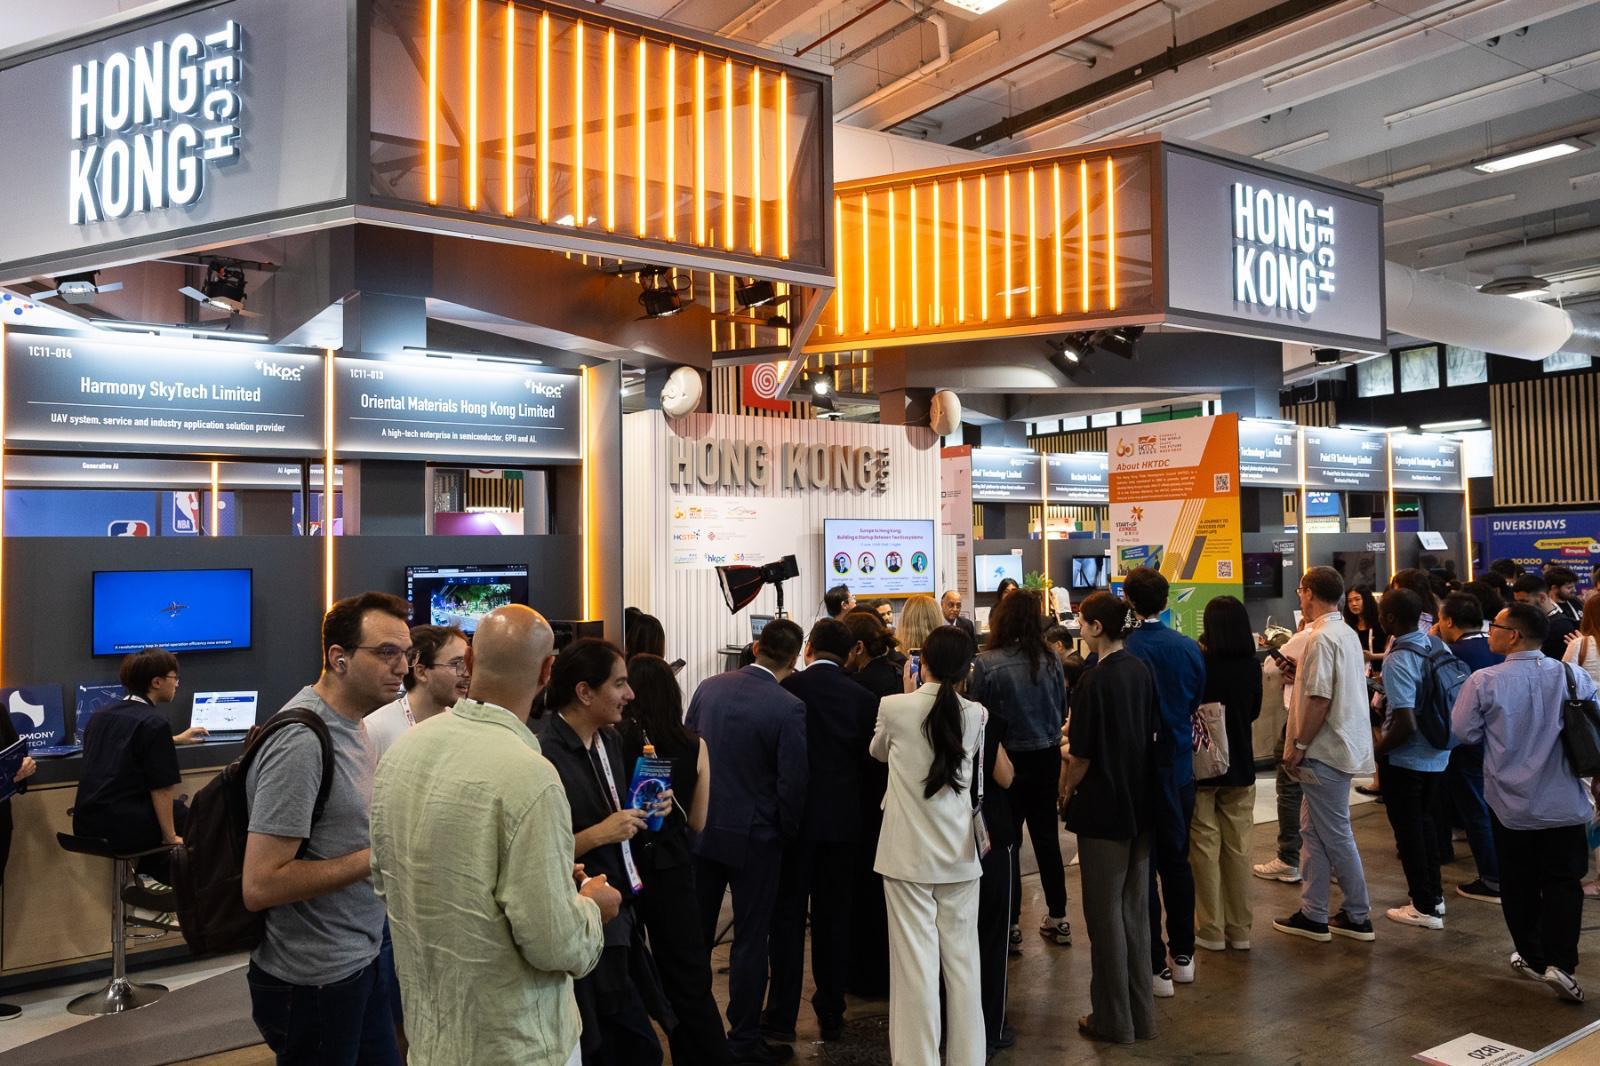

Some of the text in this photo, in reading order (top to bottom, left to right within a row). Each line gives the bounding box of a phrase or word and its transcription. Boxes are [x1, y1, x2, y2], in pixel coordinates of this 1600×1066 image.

[72, 33, 198, 139] HONG
[204, 20, 235, 160] TECH
[69, 123, 198, 225] KONG
[1235, 182, 1316, 253] HONG
[1317, 205, 1335, 293] TECH
[1237, 245, 1317, 313] KONG
[28, 346, 72, 359] 1C11-014
[263, 362, 300, 379] hkpc
[80, 376, 261, 402] Harmony SkyTech Limited
[531, 381, 562, 397] hkpc
[361, 393, 555, 420] Oriental Materials Hong Kong Limited
[51, 413, 68, 423] UAV
[103, 417, 132, 426] service
[134, 418, 148, 427] and
[150, 418, 181, 430] industry
[184, 420, 224, 431] application
[226, 421, 254, 430] solution
[256, 422, 286, 433] provider
[381, 427, 387, 437] A
[388, 428, 419, 439] high-tech
[420, 430, 451, 440] enterprise
[452, 431, 458, 440] in
[518, 434, 529, 443] and
[670, 436, 877, 491] HONG KONG
[1116, 459, 1170, 471] About HKTDC
[177, 519, 190, 529] NBA
[1493, 519, 1567, 531] DIVERSIDAYS
[19, 731, 55, 740] RMONY
